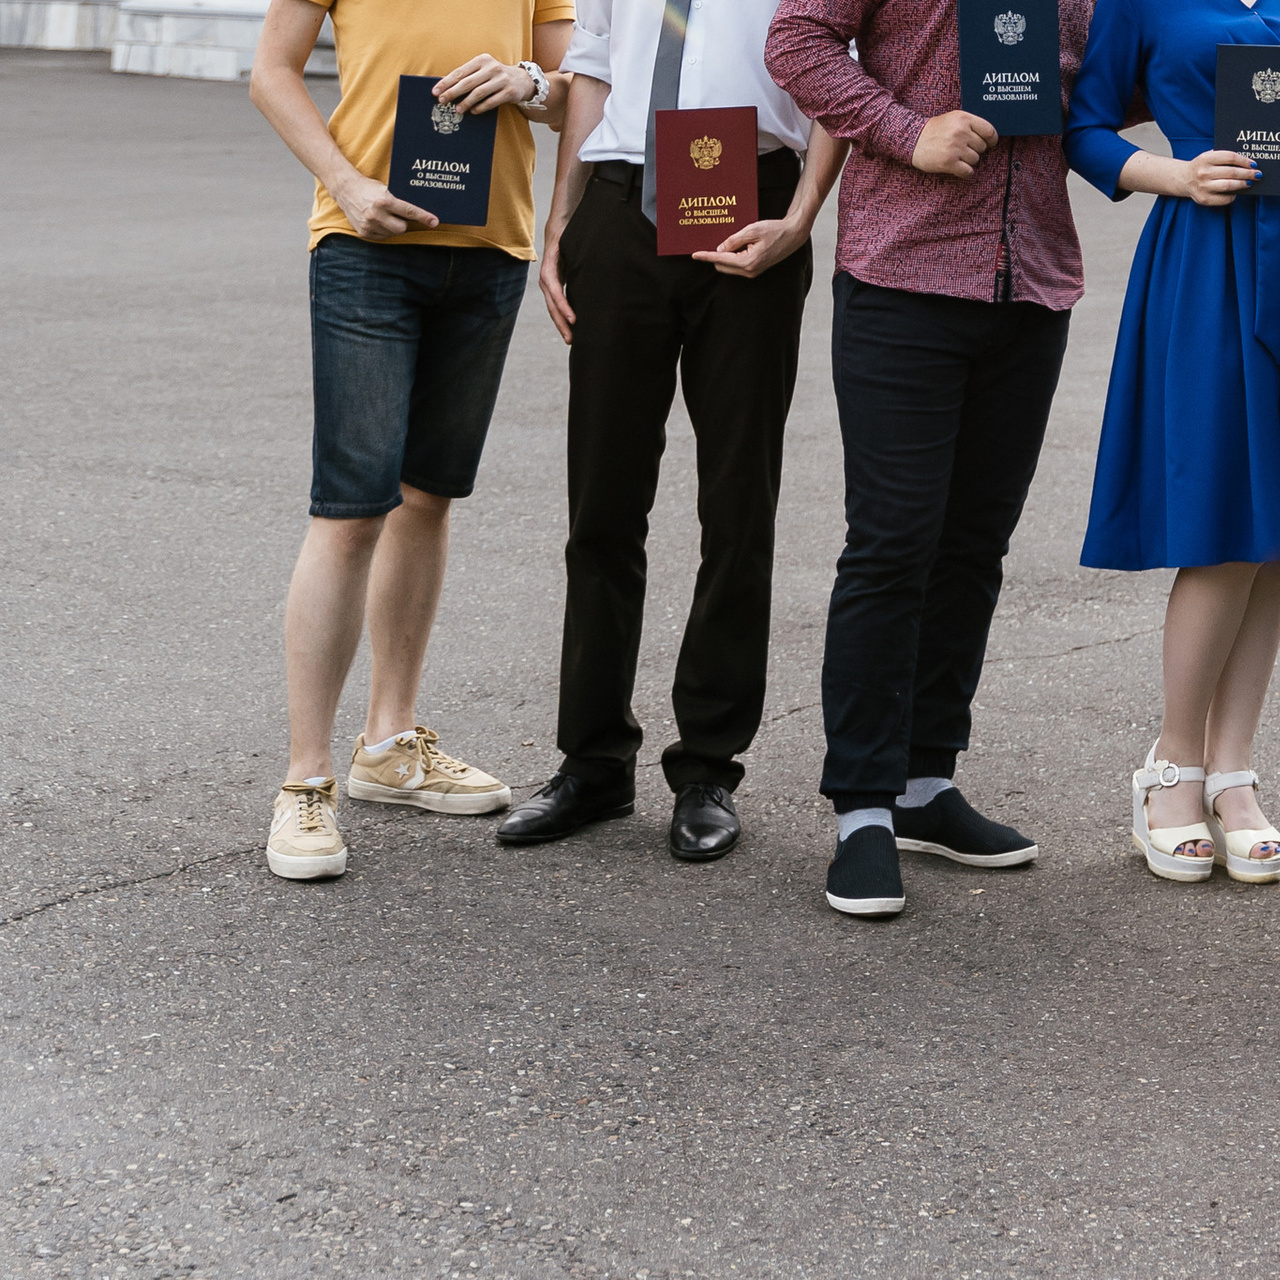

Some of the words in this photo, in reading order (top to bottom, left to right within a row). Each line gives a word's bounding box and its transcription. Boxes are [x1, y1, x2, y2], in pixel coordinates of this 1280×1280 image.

[983, 72, 1040, 85] ДИПЛОМ
[989, 85, 996, 93] О
[983, 93, 1038, 101] ОБРАЗОВАНИИ
[411, 158, 470, 174] ДИПЛОМ
[425, 173, 460, 182] ВЫСШЕМ
[410, 179, 465, 191] ОБРАЗОВАНИИ
[678, 195, 737, 210] ДИПЛОМ
[693, 208, 728, 216] ВЫСШЕМ
[679, 216, 735, 226] ОБРАЗОВАНИИ
